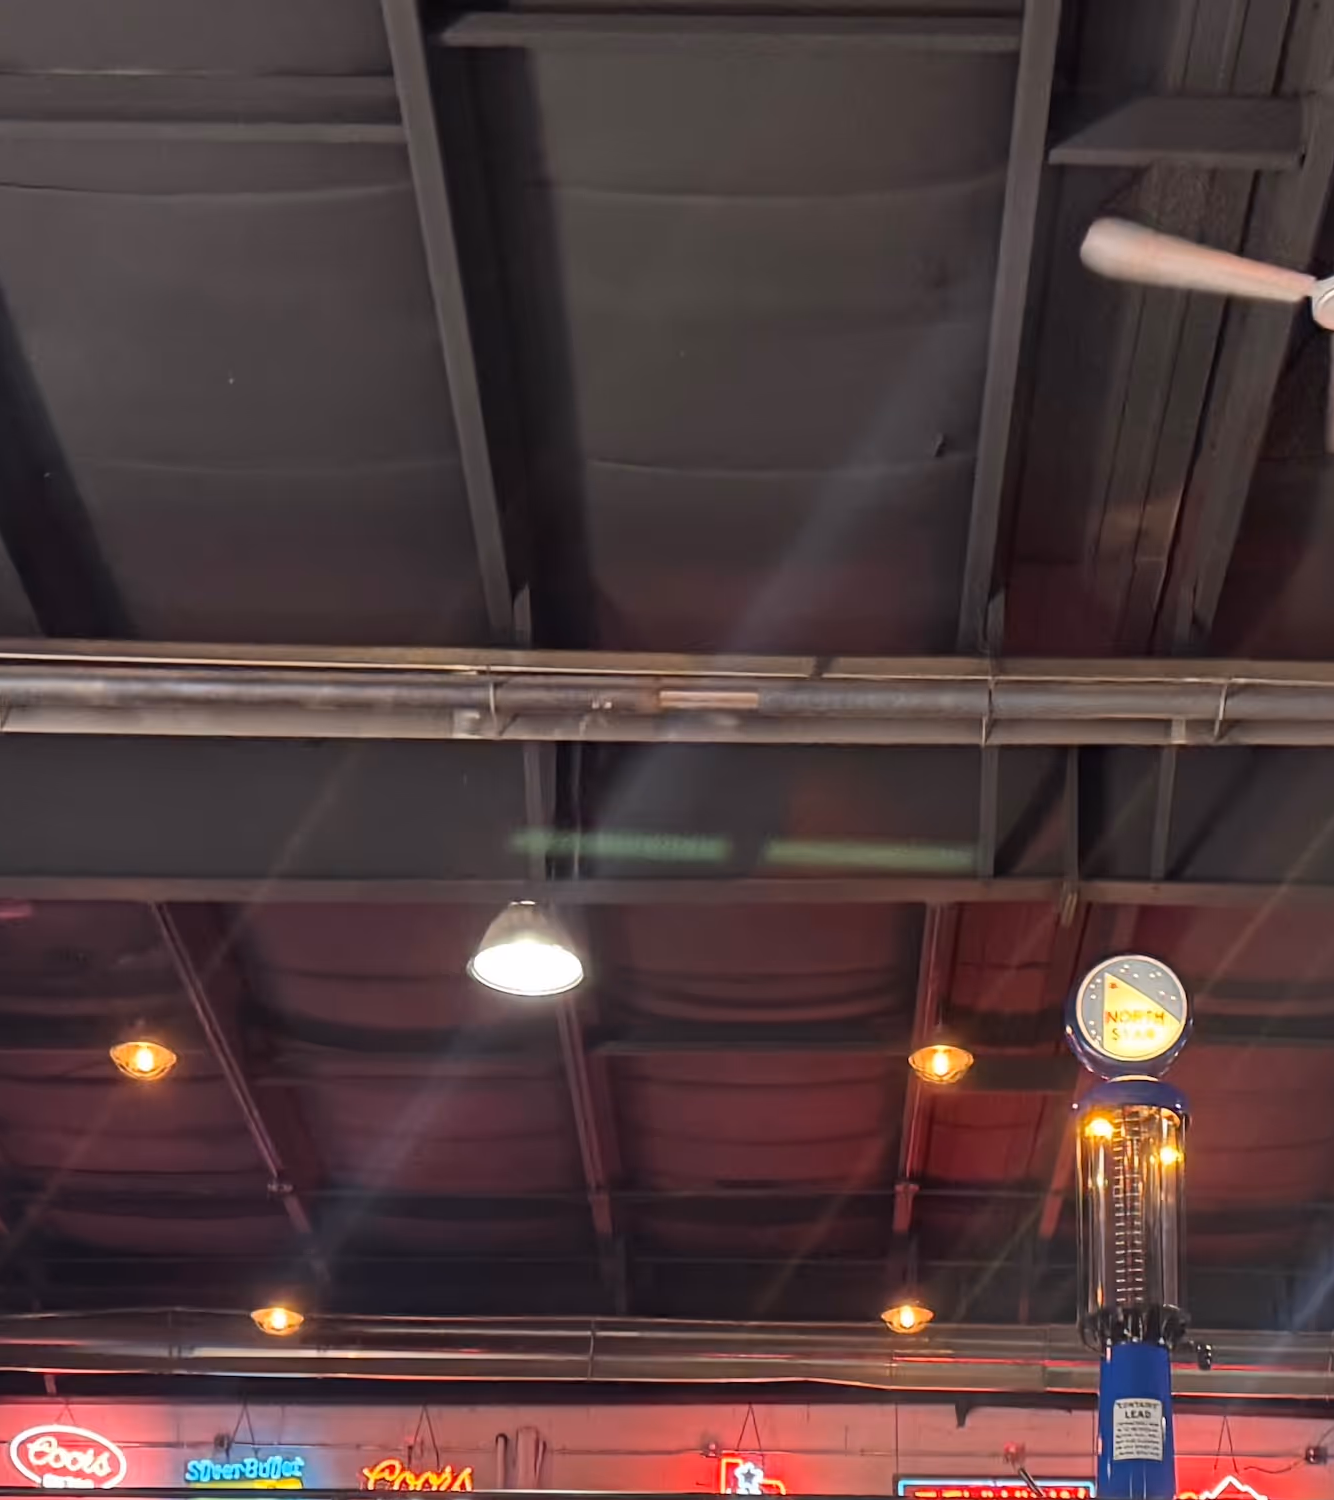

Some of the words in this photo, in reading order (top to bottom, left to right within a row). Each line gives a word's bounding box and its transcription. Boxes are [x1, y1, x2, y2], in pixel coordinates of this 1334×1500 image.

[1103, 1009, 1166, 1025] NORTH
[1124, 1410, 1152, 1419] LEAD
[26, 1436, 112, 1477] Coors
